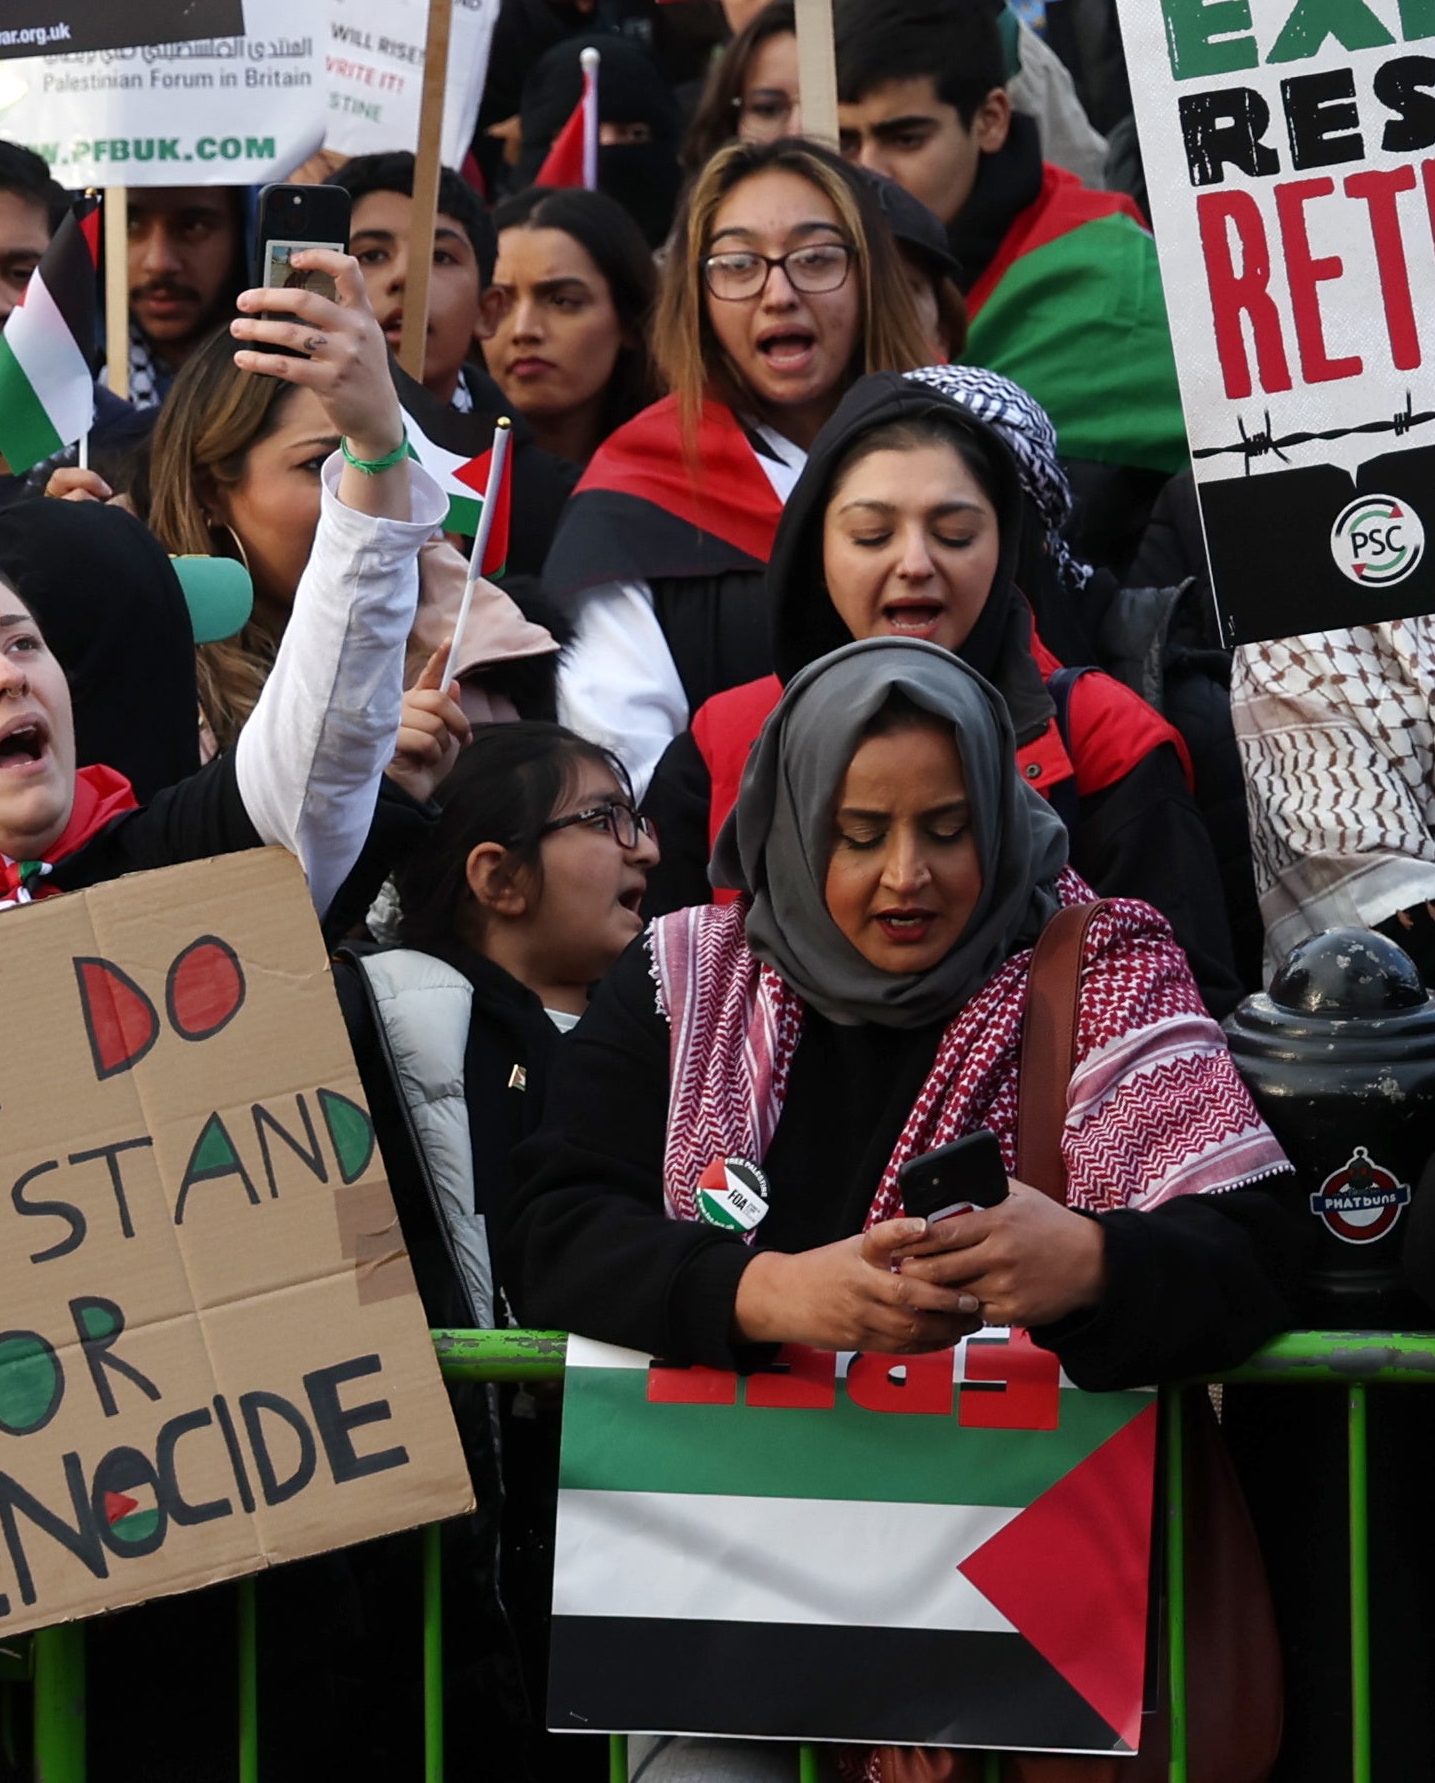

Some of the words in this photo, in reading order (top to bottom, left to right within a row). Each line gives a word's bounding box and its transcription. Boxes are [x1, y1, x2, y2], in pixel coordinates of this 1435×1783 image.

[150, 67, 214, 89] Forum
[219, 68, 237, 87] in
[244, 67, 312, 88] Britain
[1350, 525, 1408, 559] PSC
[71, 934, 247, 1082] DO
[10, 1085, 377, 1266] STAND
